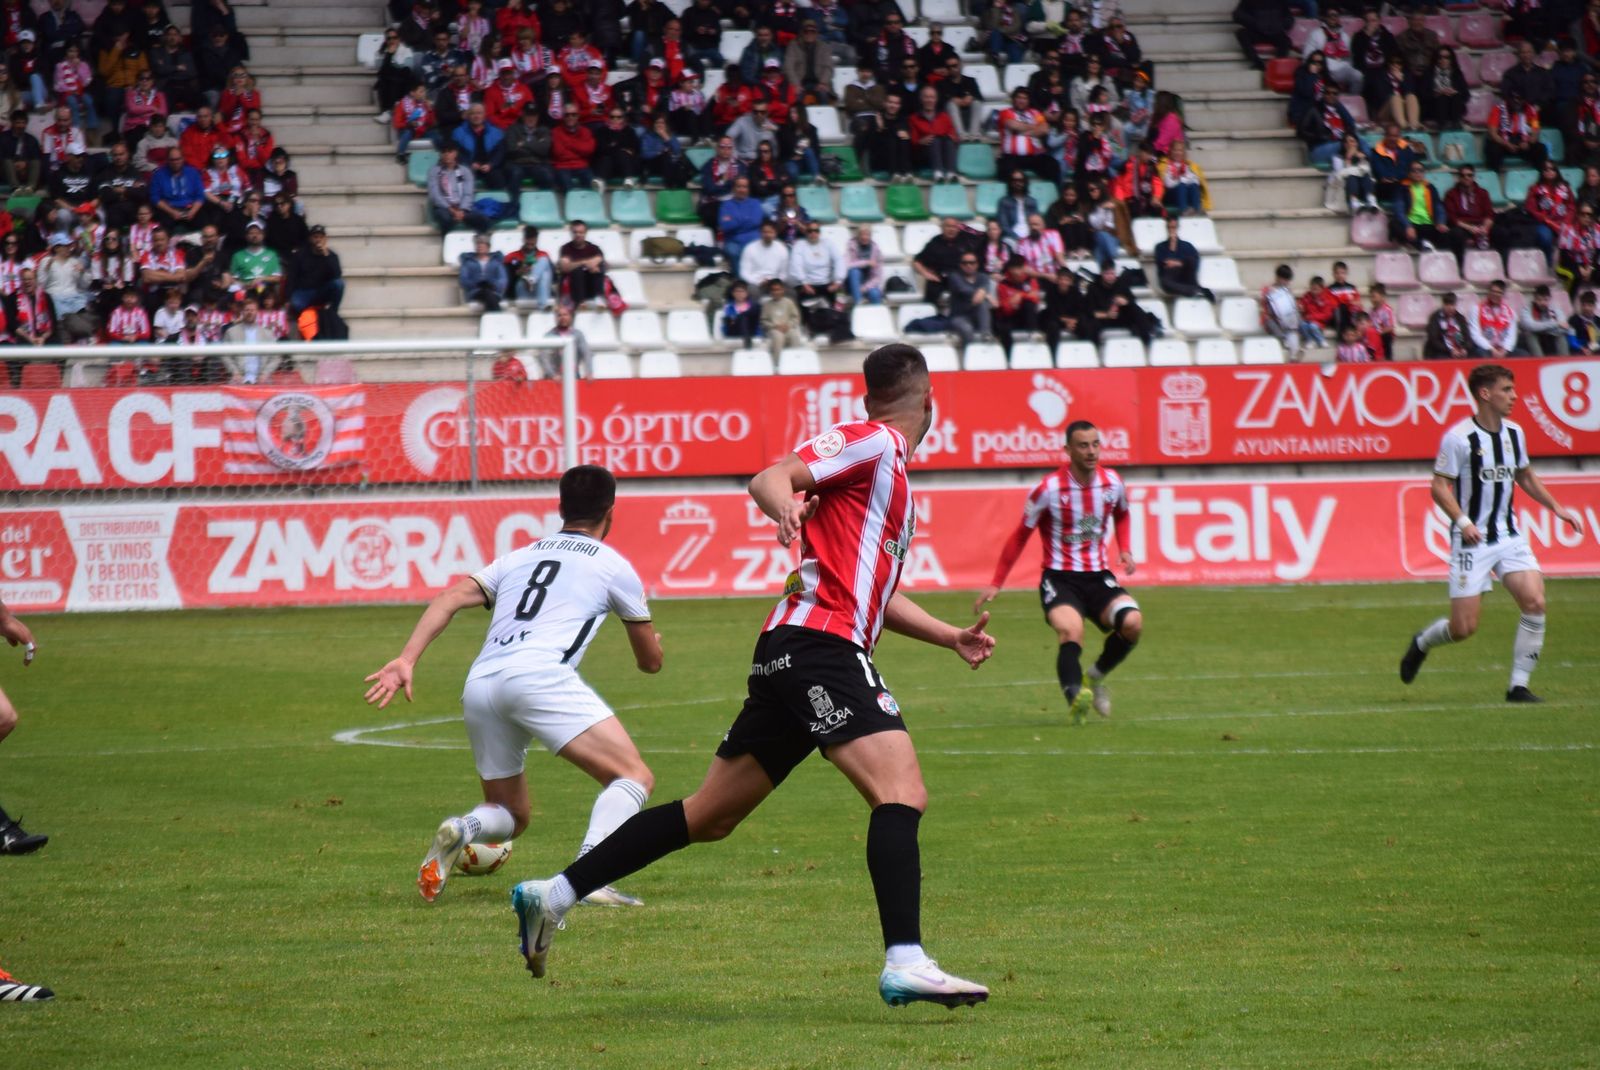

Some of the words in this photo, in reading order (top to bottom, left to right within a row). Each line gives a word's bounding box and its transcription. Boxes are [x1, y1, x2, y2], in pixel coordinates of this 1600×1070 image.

[1234, 367, 1479, 428] ZAMORA
[1562, 370, 1592, 418] 8
[428, 415, 594, 448] CENTRO
[602, 405, 751, 443] ÓPTICO
[1523, 392, 1574, 451] ZAMORA
[107, 391, 226, 484] CF
[1233, 435, 1391, 456] AYUNTAMIENTO
[1, 523, 32, 544] del
[79, 520, 161, 537] DISTRIBUIDORA
[1104, 485, 1339, 581] ítaly
[86, 543, 106, 562] DE
[109, 542, 153, 561] VINOS
[207, 514, 487, 593] ZAMORA
[495, 513, 563, 559] C
[556, 539, 600, 557] BILBAO
[84, 563, 95, 581] Y
[98, 562, 160, 581] BEBIDAS
[1457, 552, 1474, 573] 16
[87, 583, 159, 602] SELECTAS
[513, 559, 562, 621] 8
[809, 706, 854, 733] ZAMORA
